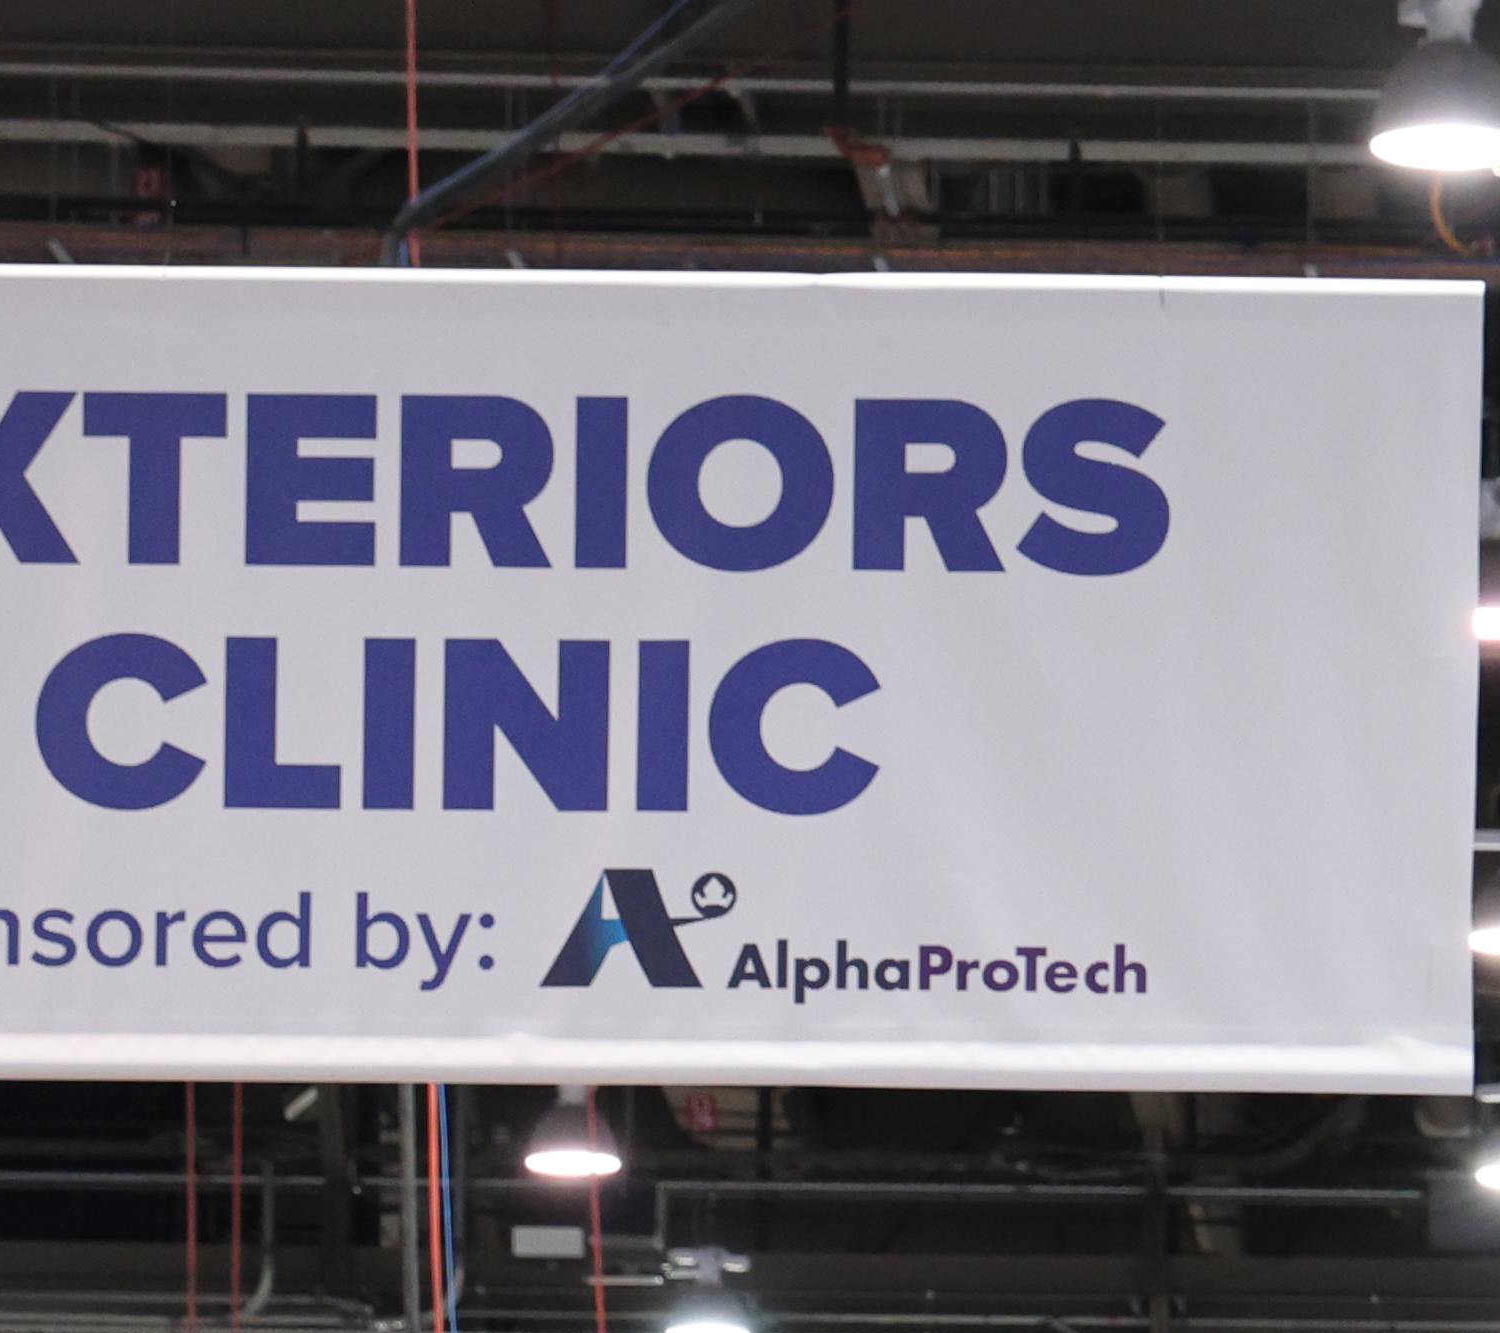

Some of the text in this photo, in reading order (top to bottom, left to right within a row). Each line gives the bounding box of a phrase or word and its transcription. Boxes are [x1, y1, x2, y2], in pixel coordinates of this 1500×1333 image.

[35, 632, 882, 817] CLINIC
[354, 890, 495, 992] by:
[727, 938, 1148, 1003] AlphaProTech
